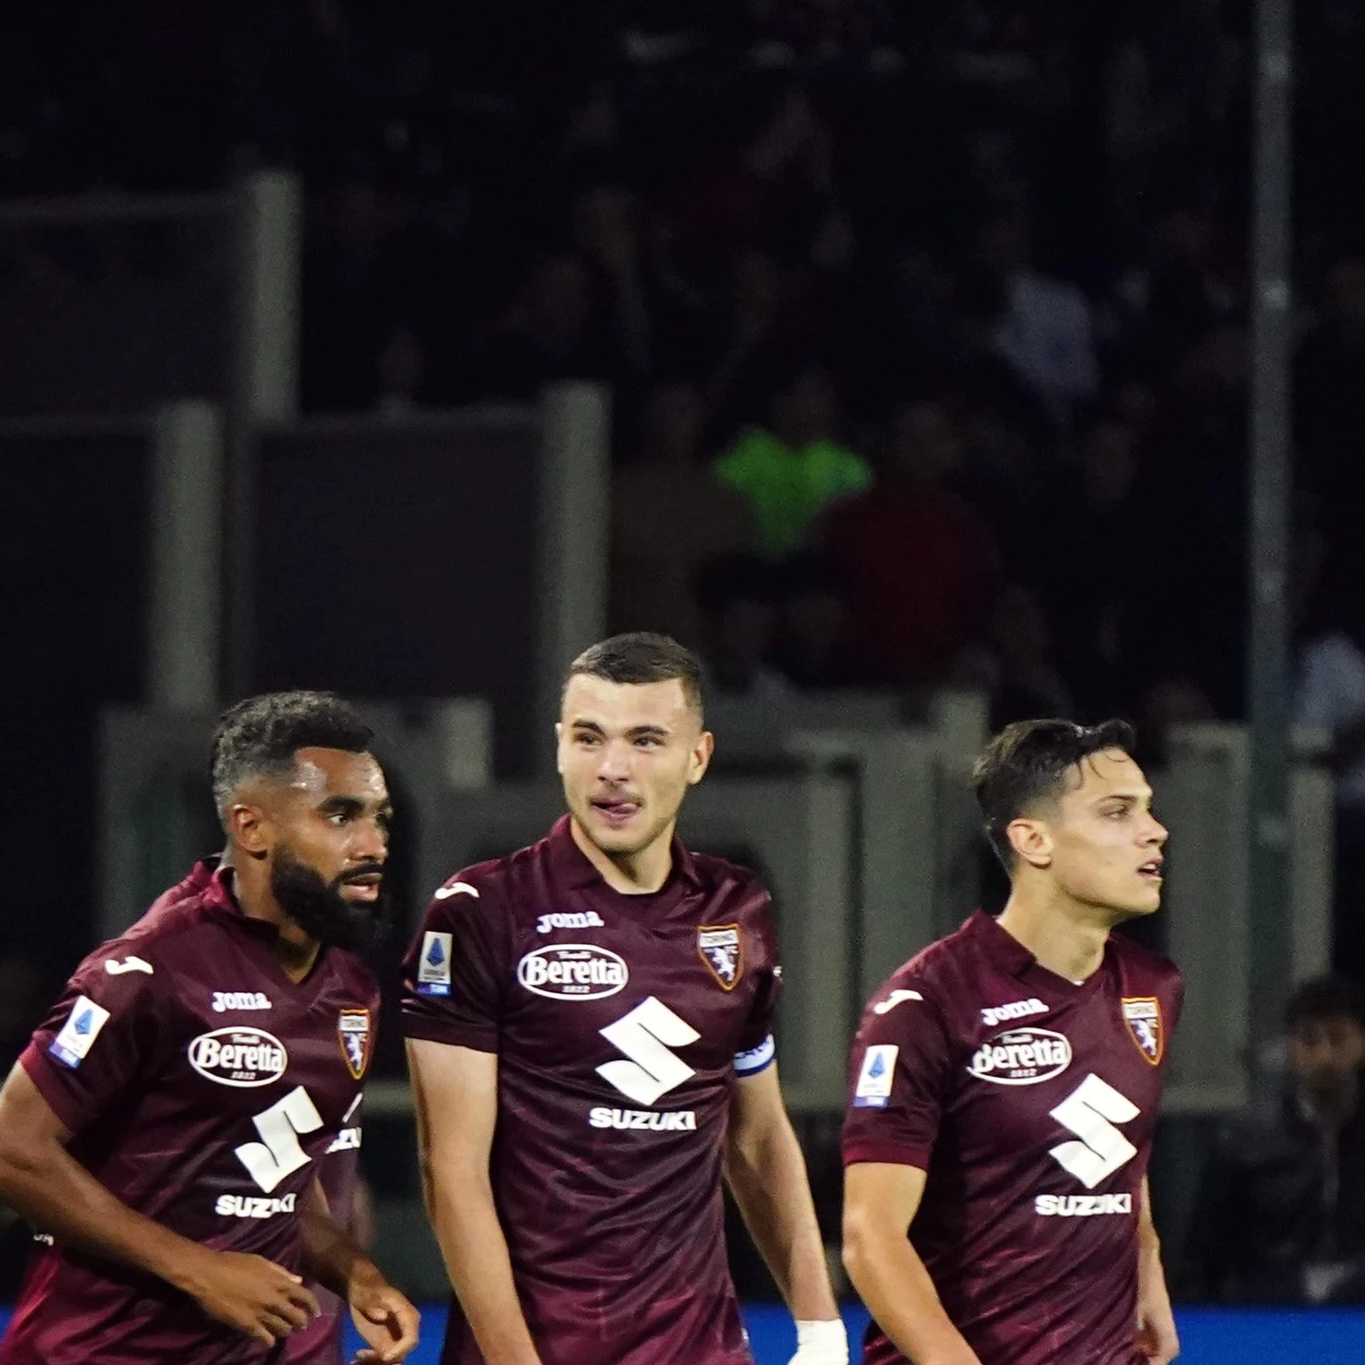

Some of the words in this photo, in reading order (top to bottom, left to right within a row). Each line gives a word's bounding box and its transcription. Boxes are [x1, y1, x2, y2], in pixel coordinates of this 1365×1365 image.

[536, 910, 605, 933] Joma
[526, 956, 625, 985] Beretta
[212, 992, 272, 1012] Joma
[981, 998, 1049, 1026] Joma
[198, 1037, 284, 1072] Beretta
[972, 1039, 1068, 1074] Beretta
[589, 1107, 696, 1131] SUZUKI
[215, 1194, 297, 1219] SUZKI
